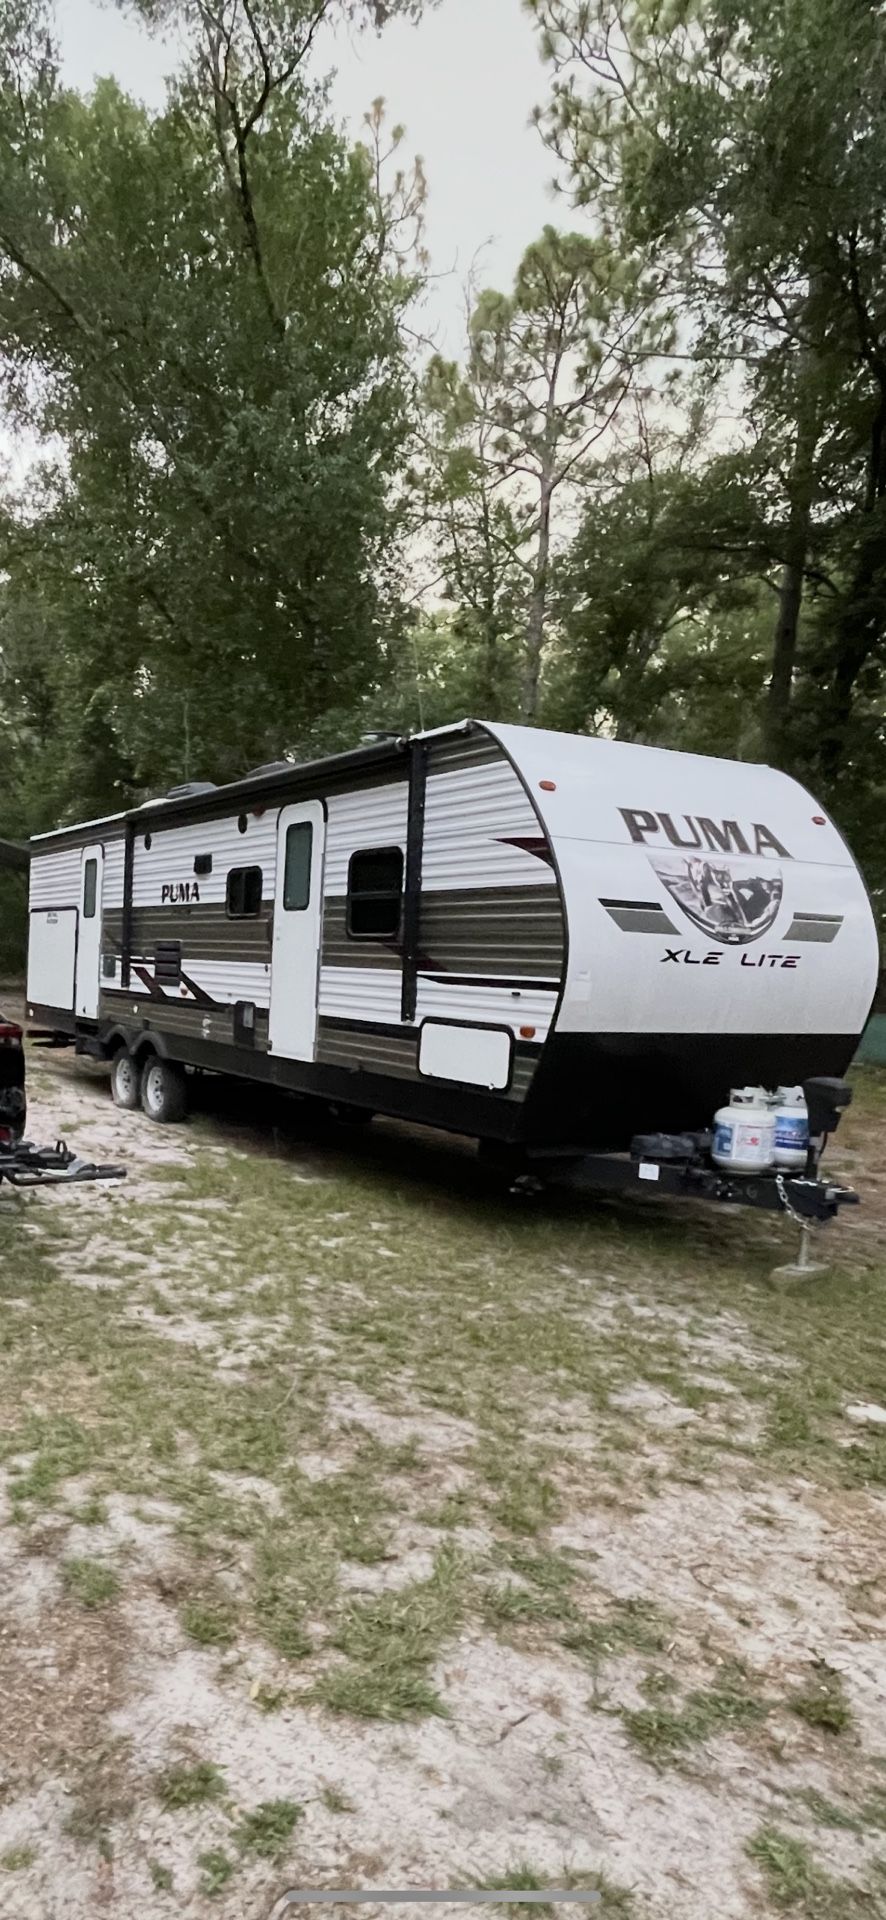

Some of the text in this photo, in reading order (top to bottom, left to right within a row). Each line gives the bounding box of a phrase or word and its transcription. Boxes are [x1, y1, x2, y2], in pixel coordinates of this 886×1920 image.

[616, 807, 795, 859] PUMA
[161, 882, 200, 904] PUMA
[660, 949, 801, 968] XLE LITE
